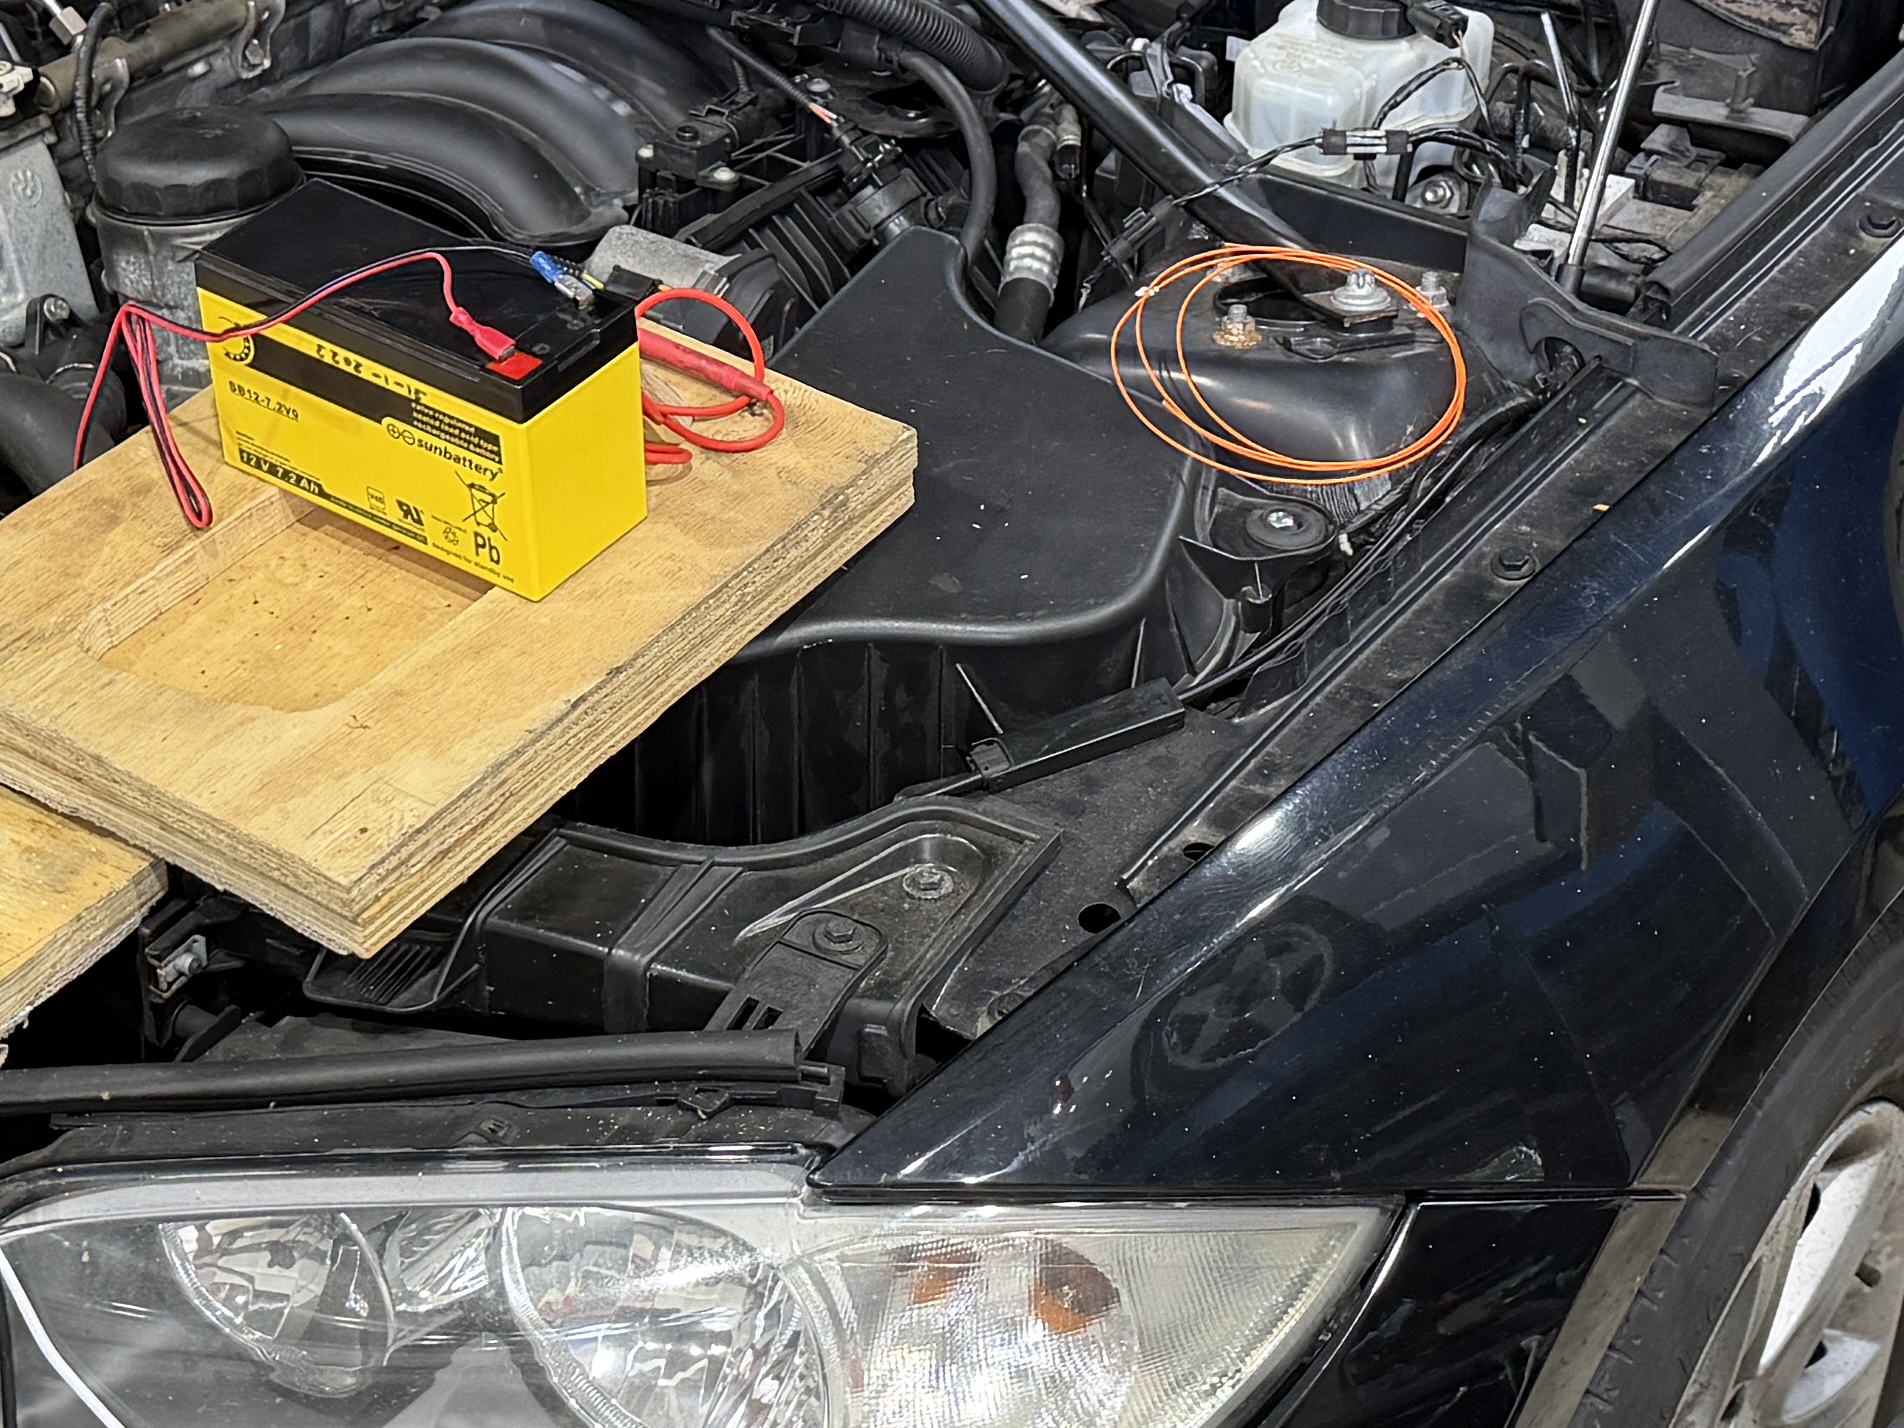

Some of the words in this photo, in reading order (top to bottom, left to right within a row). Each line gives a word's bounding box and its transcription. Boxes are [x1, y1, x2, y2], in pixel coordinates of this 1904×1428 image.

[241, 451, 257, 466] 12
[260, 458, 270, 472] V
[299, 475, 319, 494] Ah
[473, 530, 501, 566] Pb
